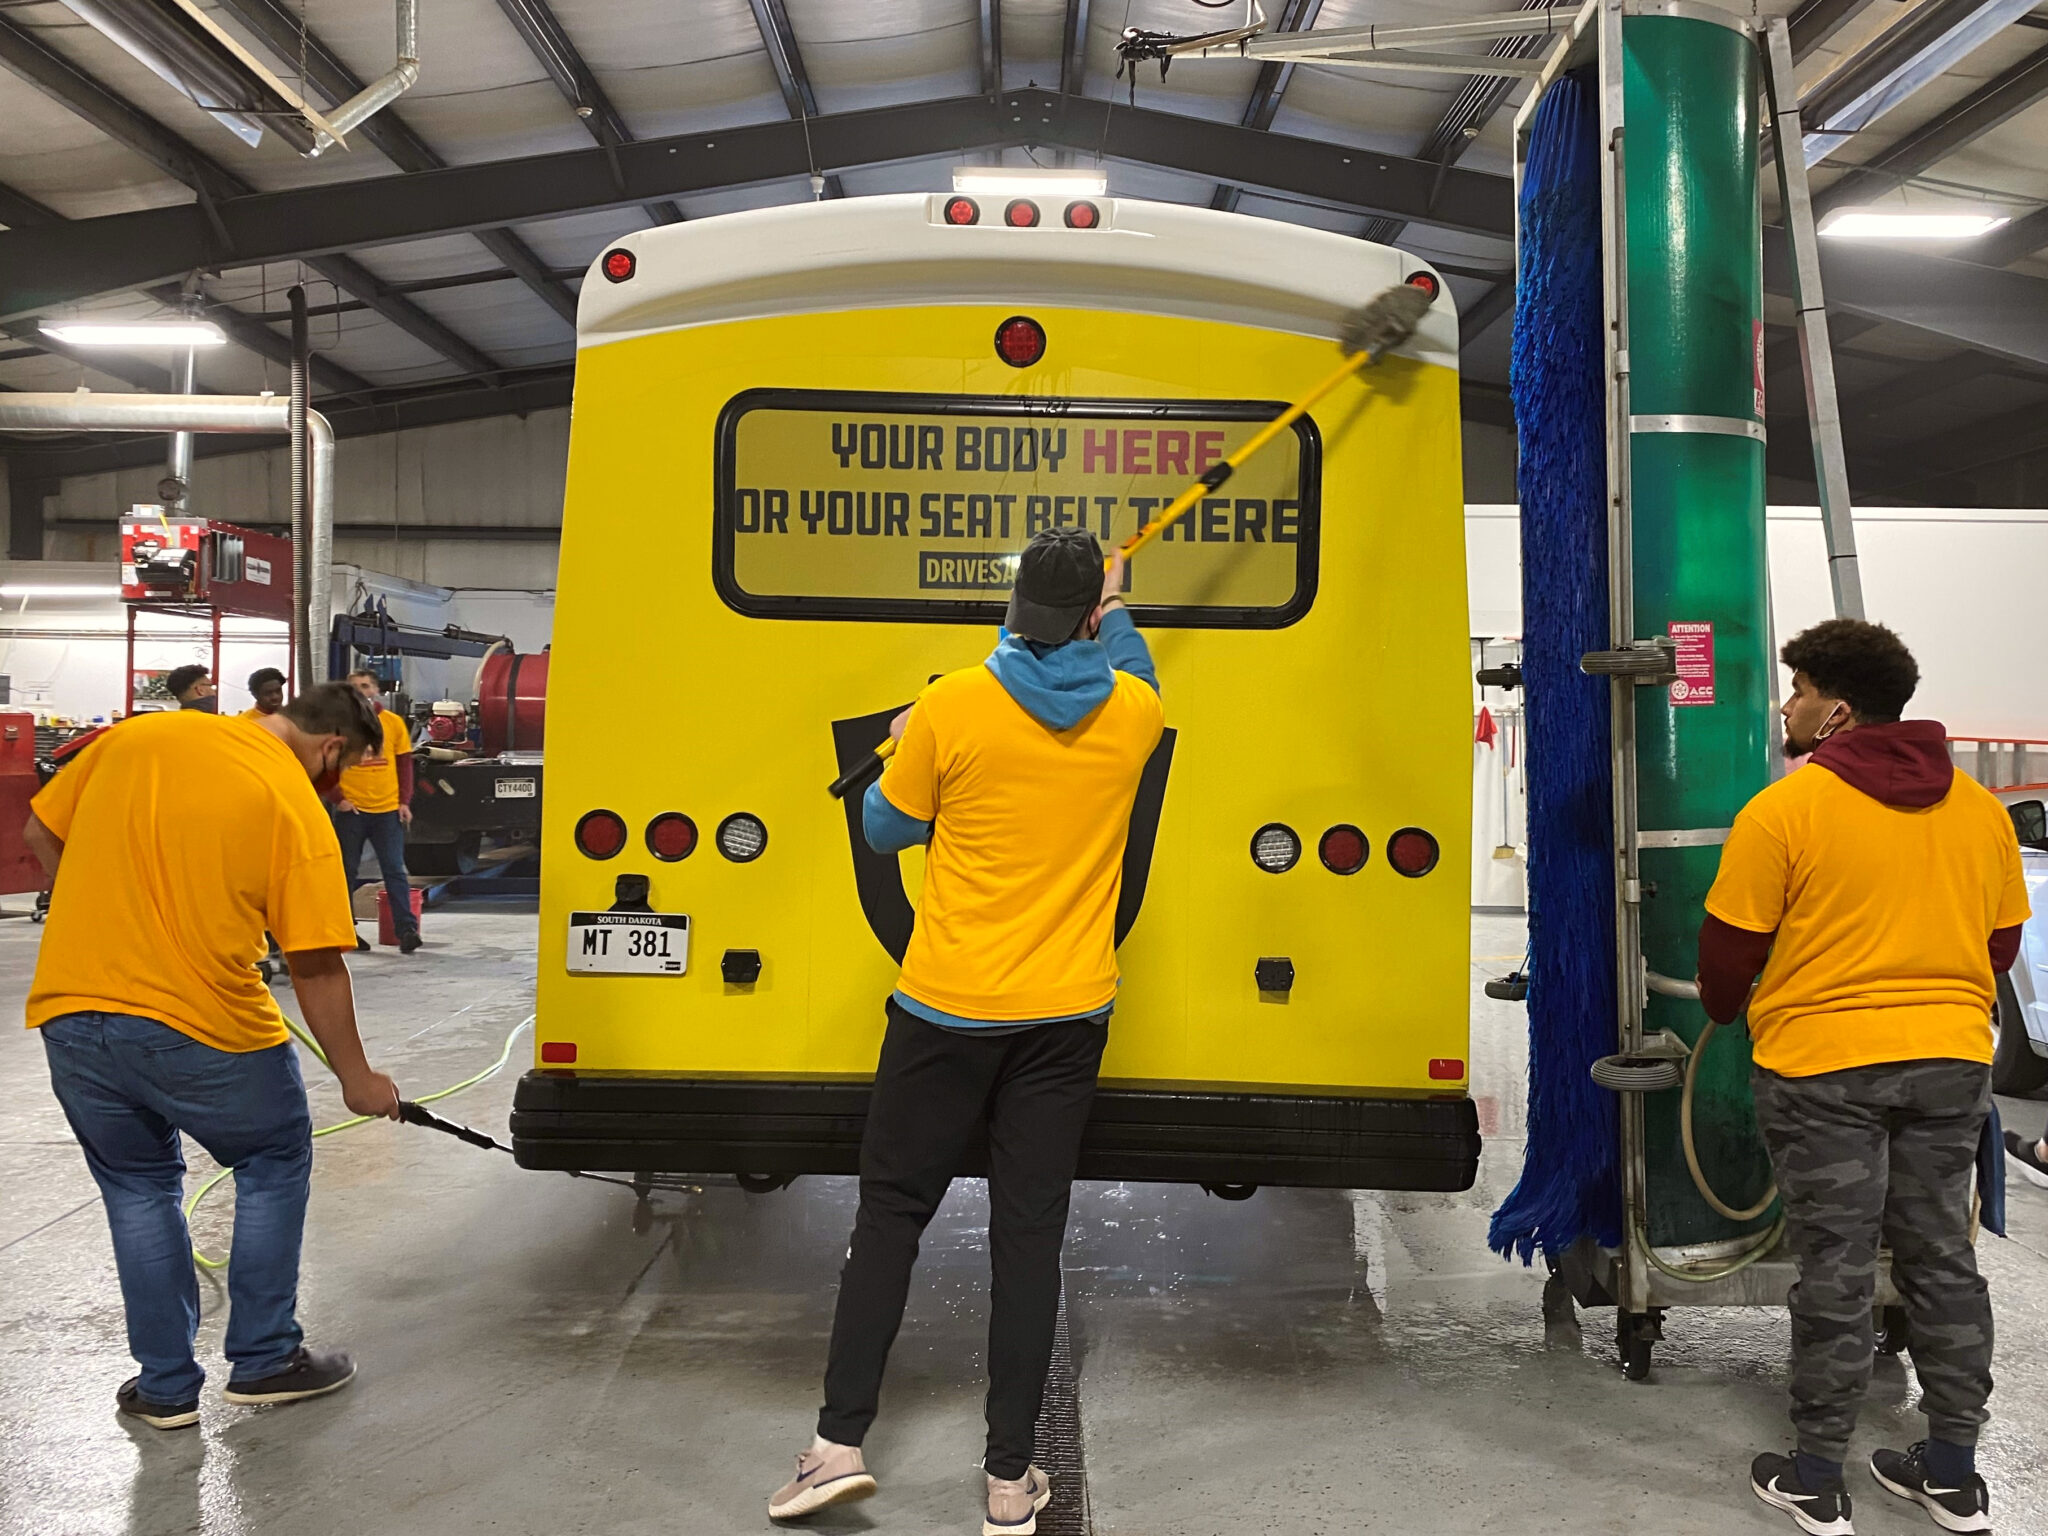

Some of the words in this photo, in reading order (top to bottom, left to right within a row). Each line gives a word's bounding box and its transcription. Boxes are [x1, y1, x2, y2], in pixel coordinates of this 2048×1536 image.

[832, 423, 944, 472] YOUR
[956, 426, 1067, 474] BODY
[1083, 428, 1225, 475] HERE
[735, 488, 790, 535] OR
[800, 490, 909, 537] YOUR
[920, 493, 1017, 538] SEAT
[1027, 495, 1118, 540] BELT
[1129, 497, 1298, 543] THERE
[926, 558, 1017, 584] DRIVESA
[1671, 624, 1711, 633] ATTENTION
[597, 915, 626, 924] SOUTH
[628, 916, 662, 925] DAKOTA
[583, 929, 612, 955] MT
[628, 930, 671, 957] 381
